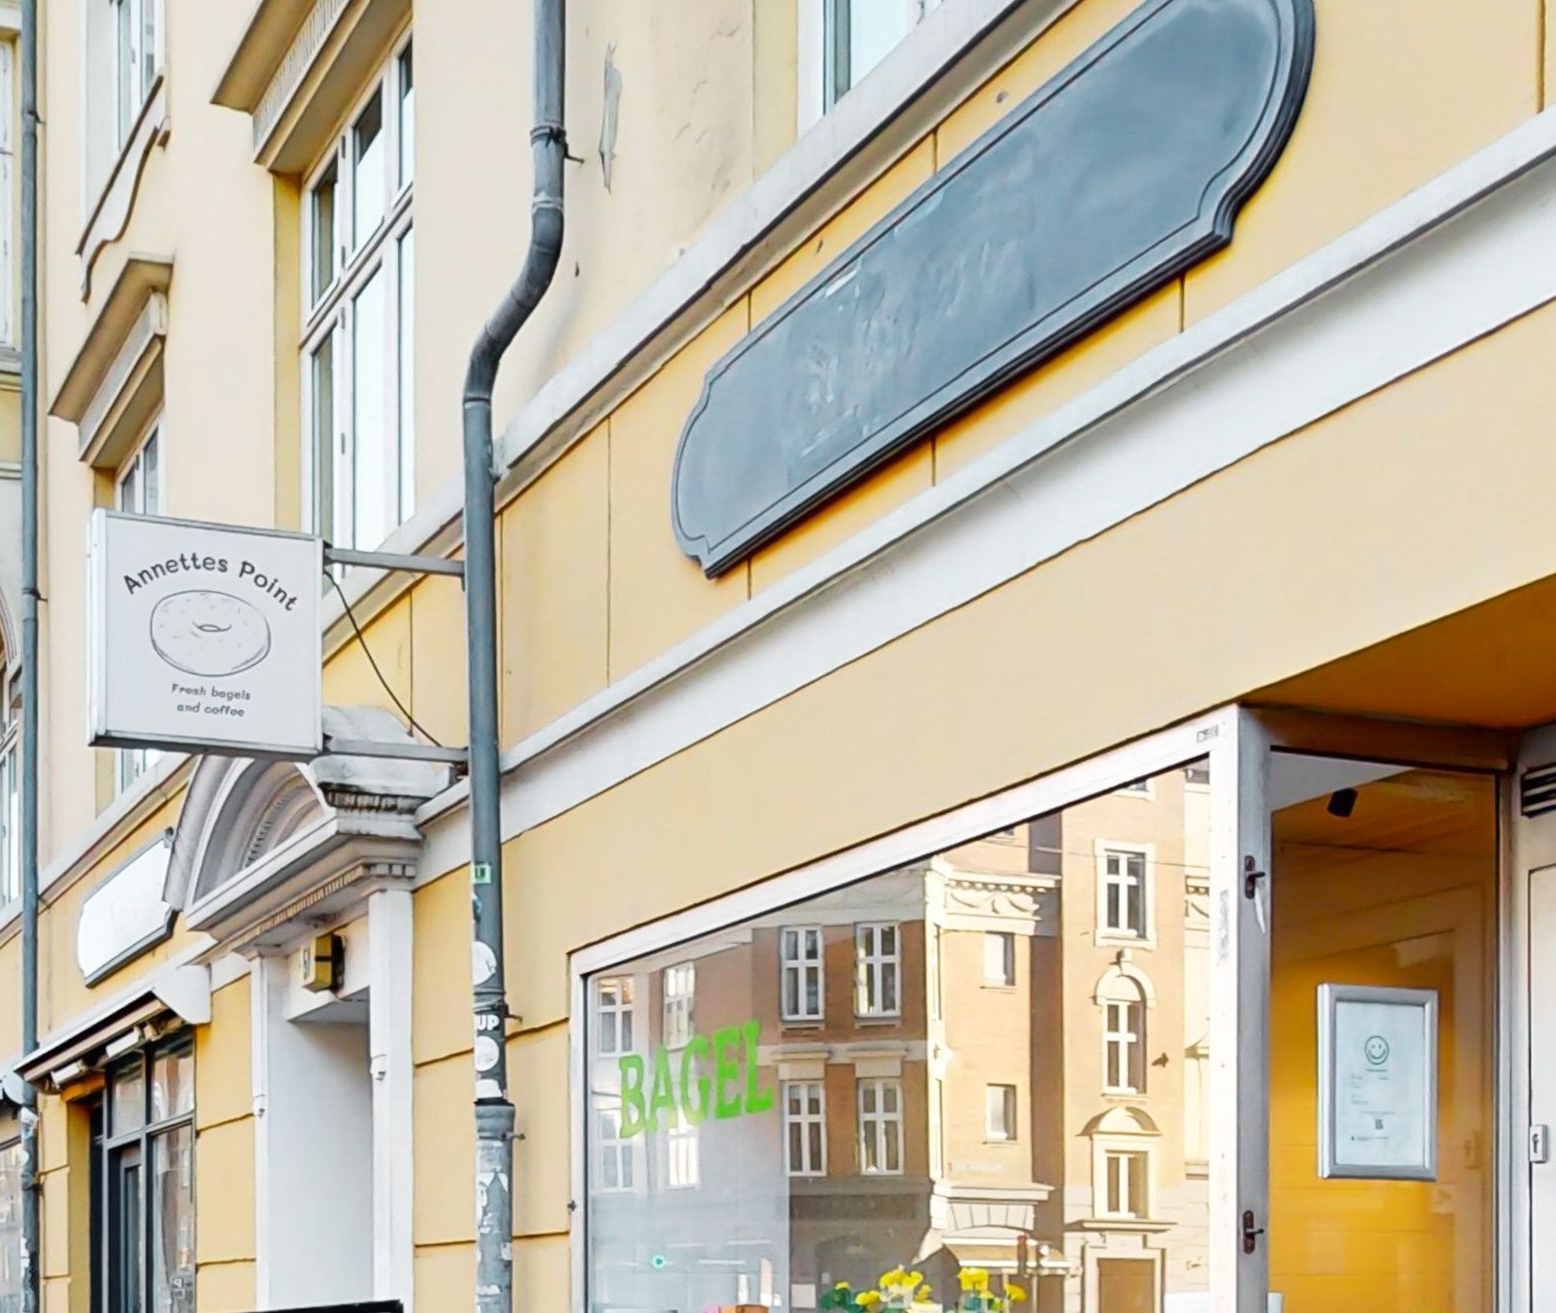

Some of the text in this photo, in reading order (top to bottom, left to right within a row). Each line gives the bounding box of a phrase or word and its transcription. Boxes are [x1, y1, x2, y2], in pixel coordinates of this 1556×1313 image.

[123, 552, 300, 612] Annettes Point
[171, 683, 251, 701] Fresh bagels
[177, 701, 244, 717] and coffee
[618, 1018, 773, 1138] BAGEL
